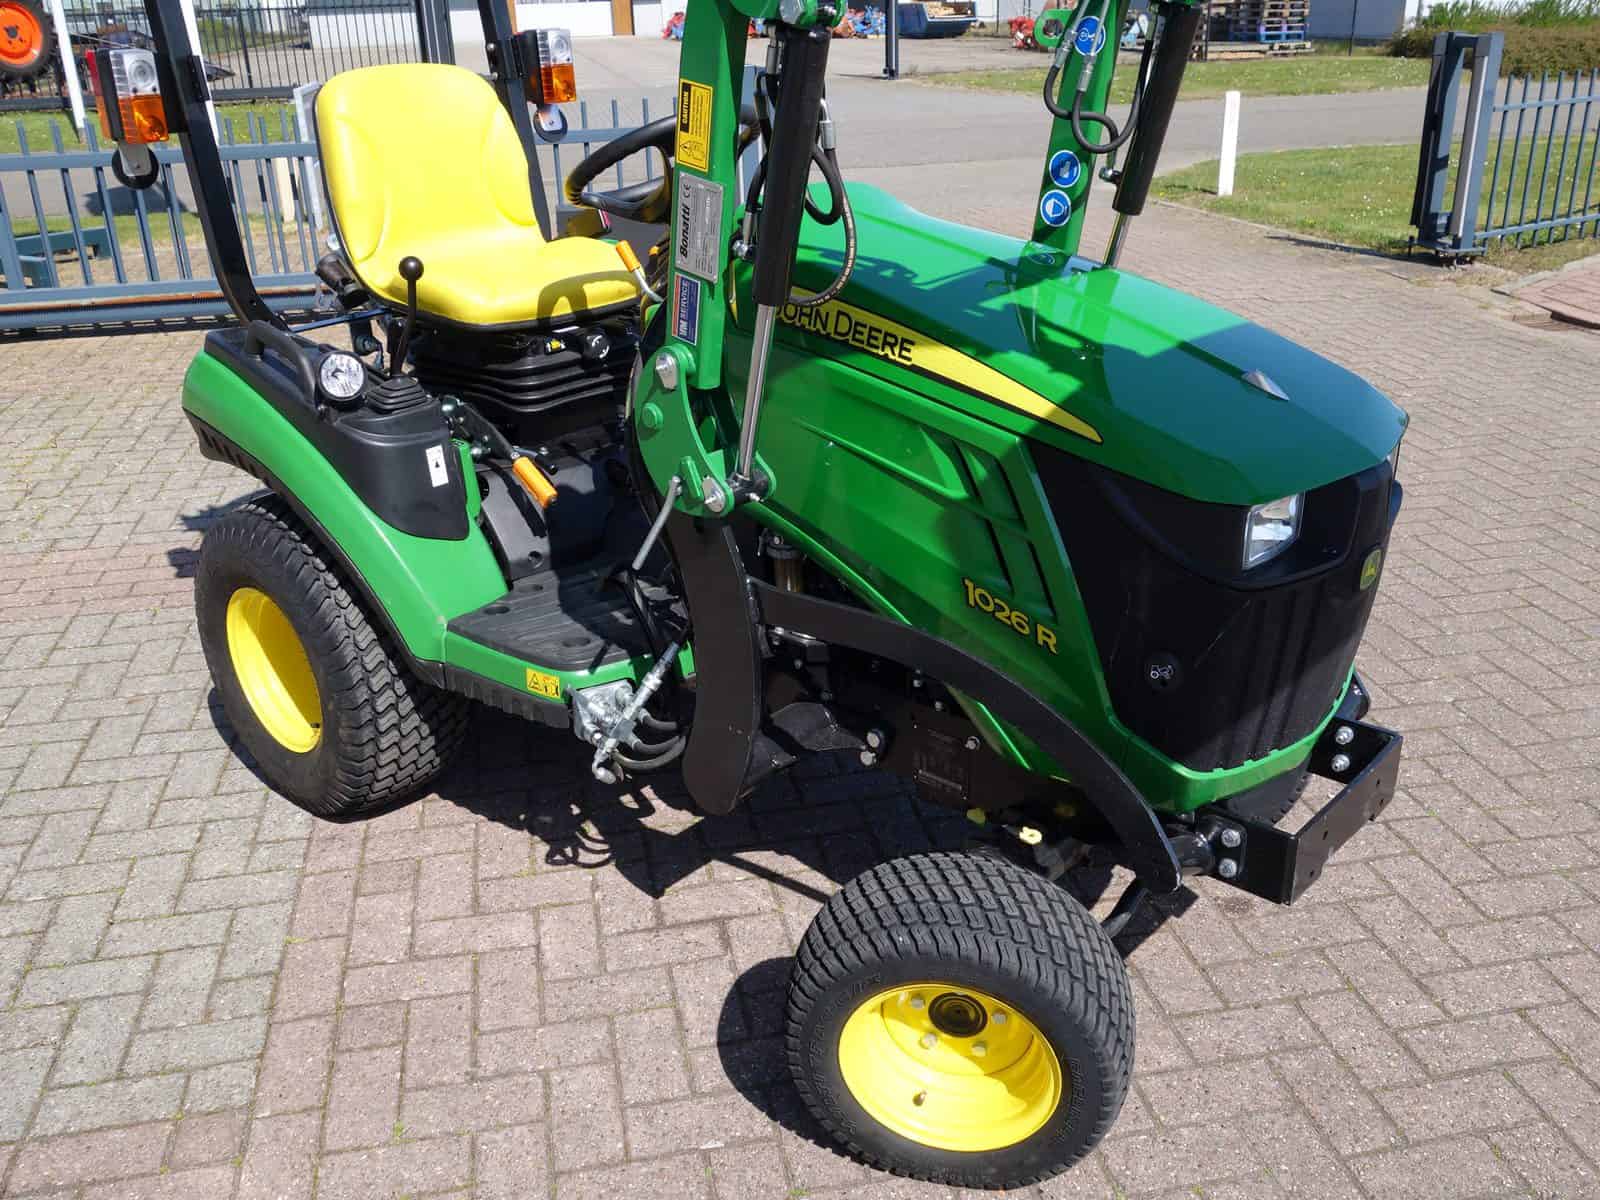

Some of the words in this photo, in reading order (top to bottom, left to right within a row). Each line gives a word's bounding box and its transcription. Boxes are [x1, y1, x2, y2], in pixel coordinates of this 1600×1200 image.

[681, 91, 690, 125] CAUTION
[680, 203, 691, 258] Bonatti
[833, 309, 916, 362] DEERE
[963, 578, 1030, 635] 1026
[1036, 623, 1057, 655] R
